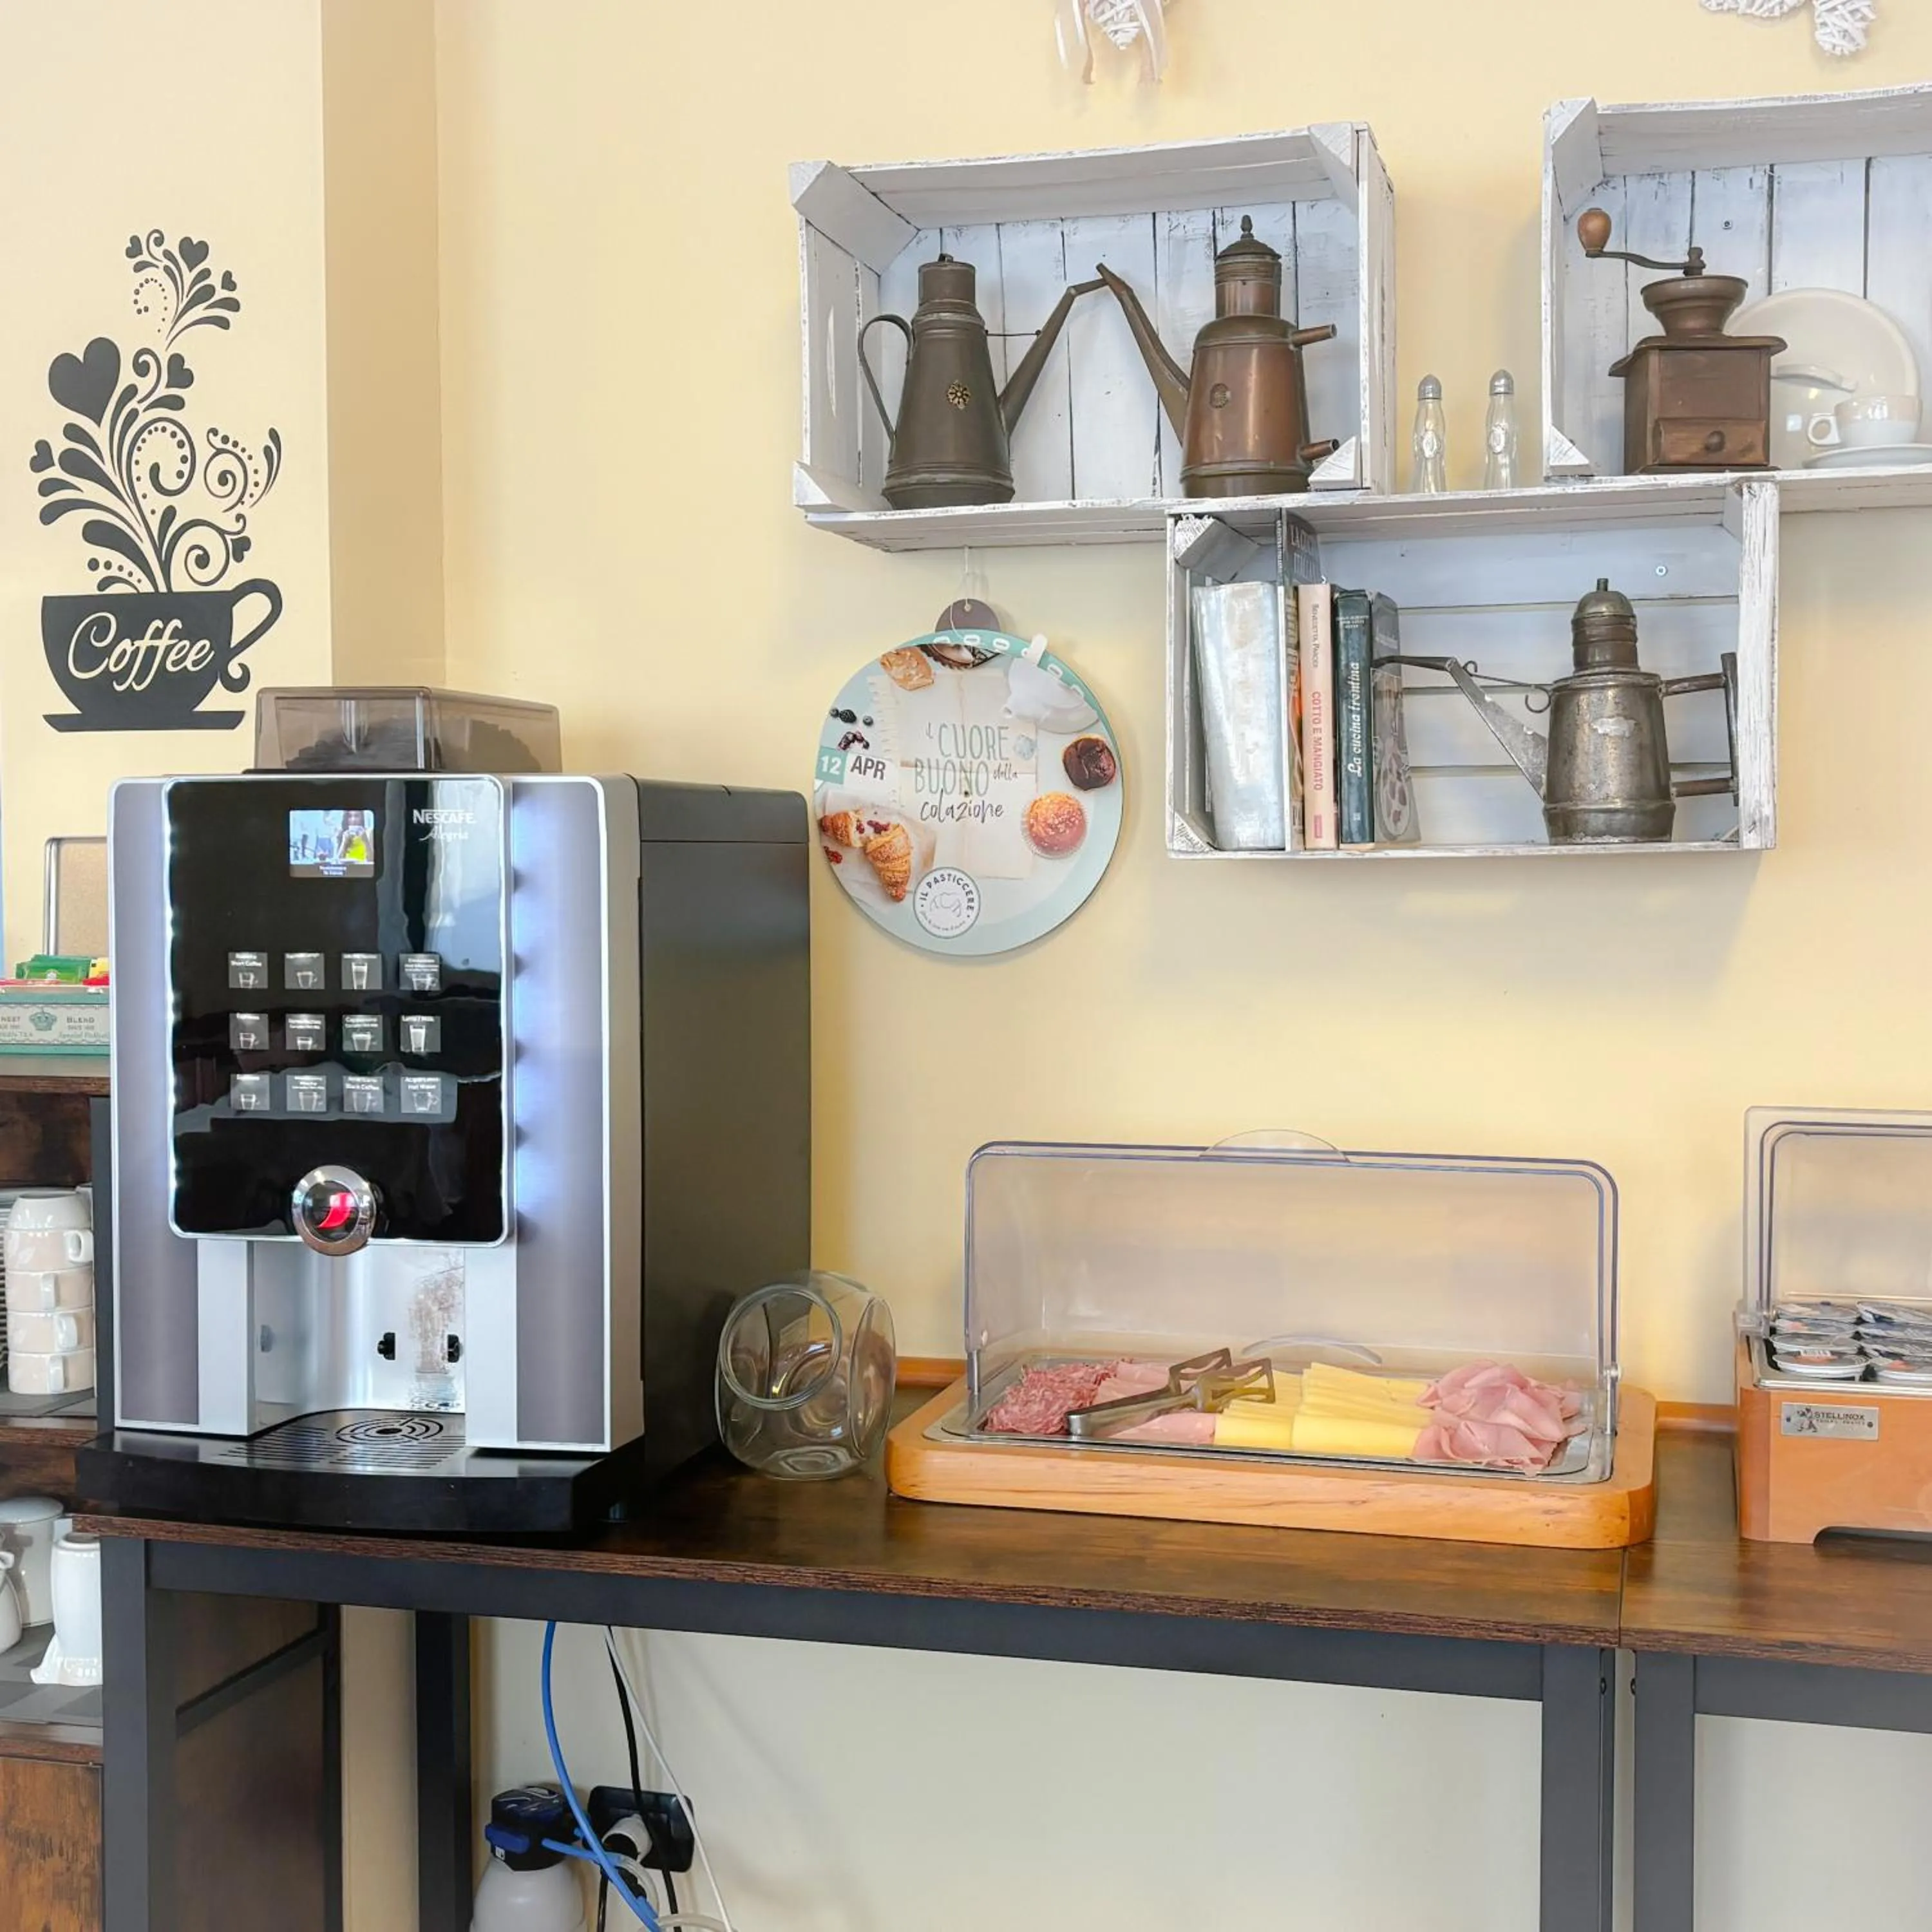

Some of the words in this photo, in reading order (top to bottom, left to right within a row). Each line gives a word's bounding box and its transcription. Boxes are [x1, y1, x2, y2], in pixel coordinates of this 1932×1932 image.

[68, 611, 215, 692] Coffee
[1311, 691, 1321, 725] COTTO
[938, 723, 1009, 761] CUORE
[1312, 727, 1321, 736] E
[820, 755, 842, 775] 12
[850, 755, 886, 781] APR
[914, 757, 989, 797] BUONO
[1312, 737, 1323, 791] MANGIATO
[920, 788, 1003, 824] colazione
[919, 892, 928, 901] IL
[926, 873, 974, 911] PASTICCERE
